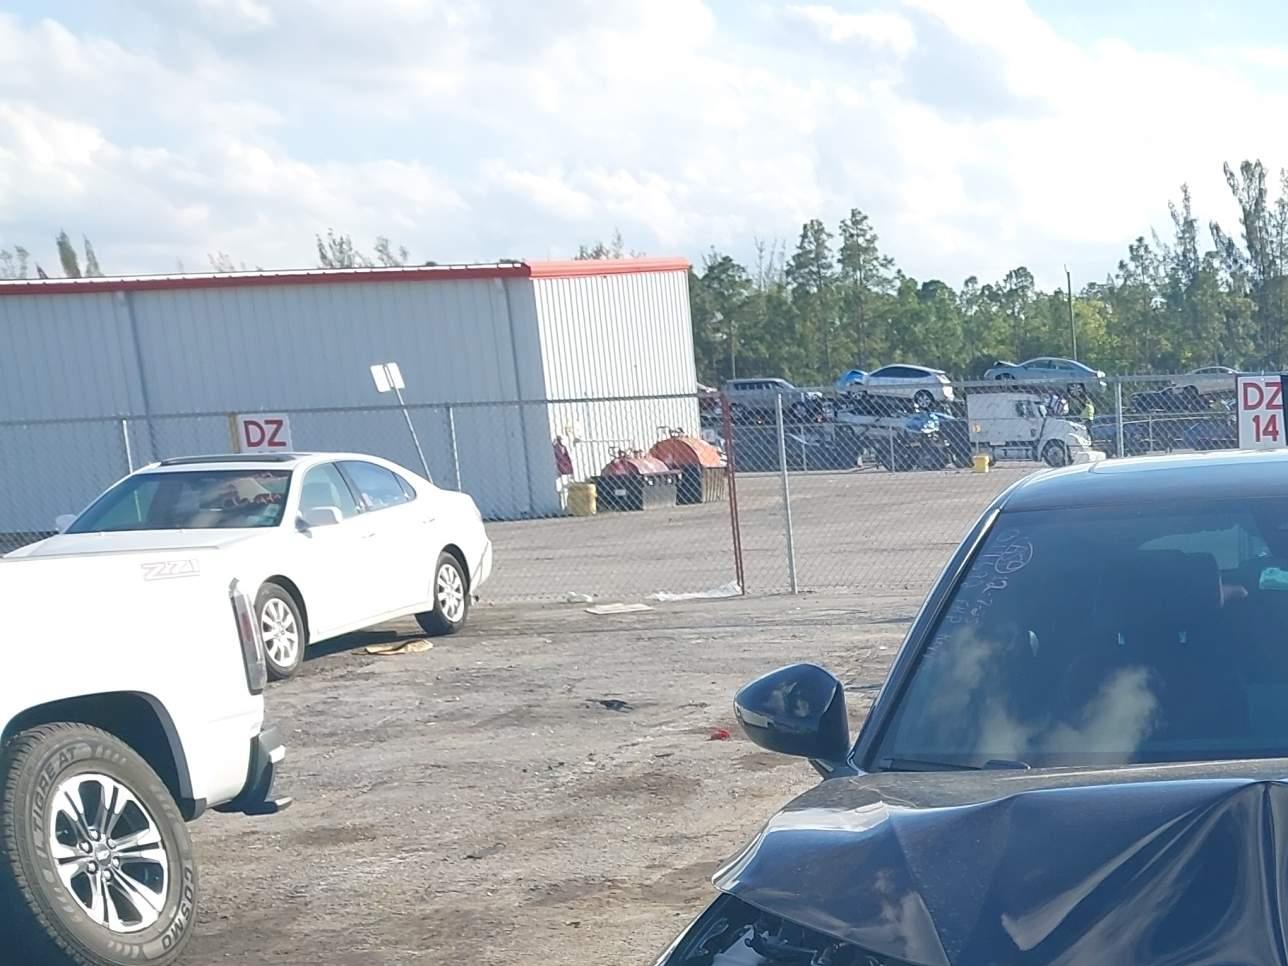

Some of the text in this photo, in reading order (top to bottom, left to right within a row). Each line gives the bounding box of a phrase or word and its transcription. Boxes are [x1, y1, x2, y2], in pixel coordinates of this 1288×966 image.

[1242, 382, 1284, 411] DZ
[243, 419, 287, 447] DZ
[1252, 414, 1279, 442] 14
[161, 865, 193, 950] COSMO
